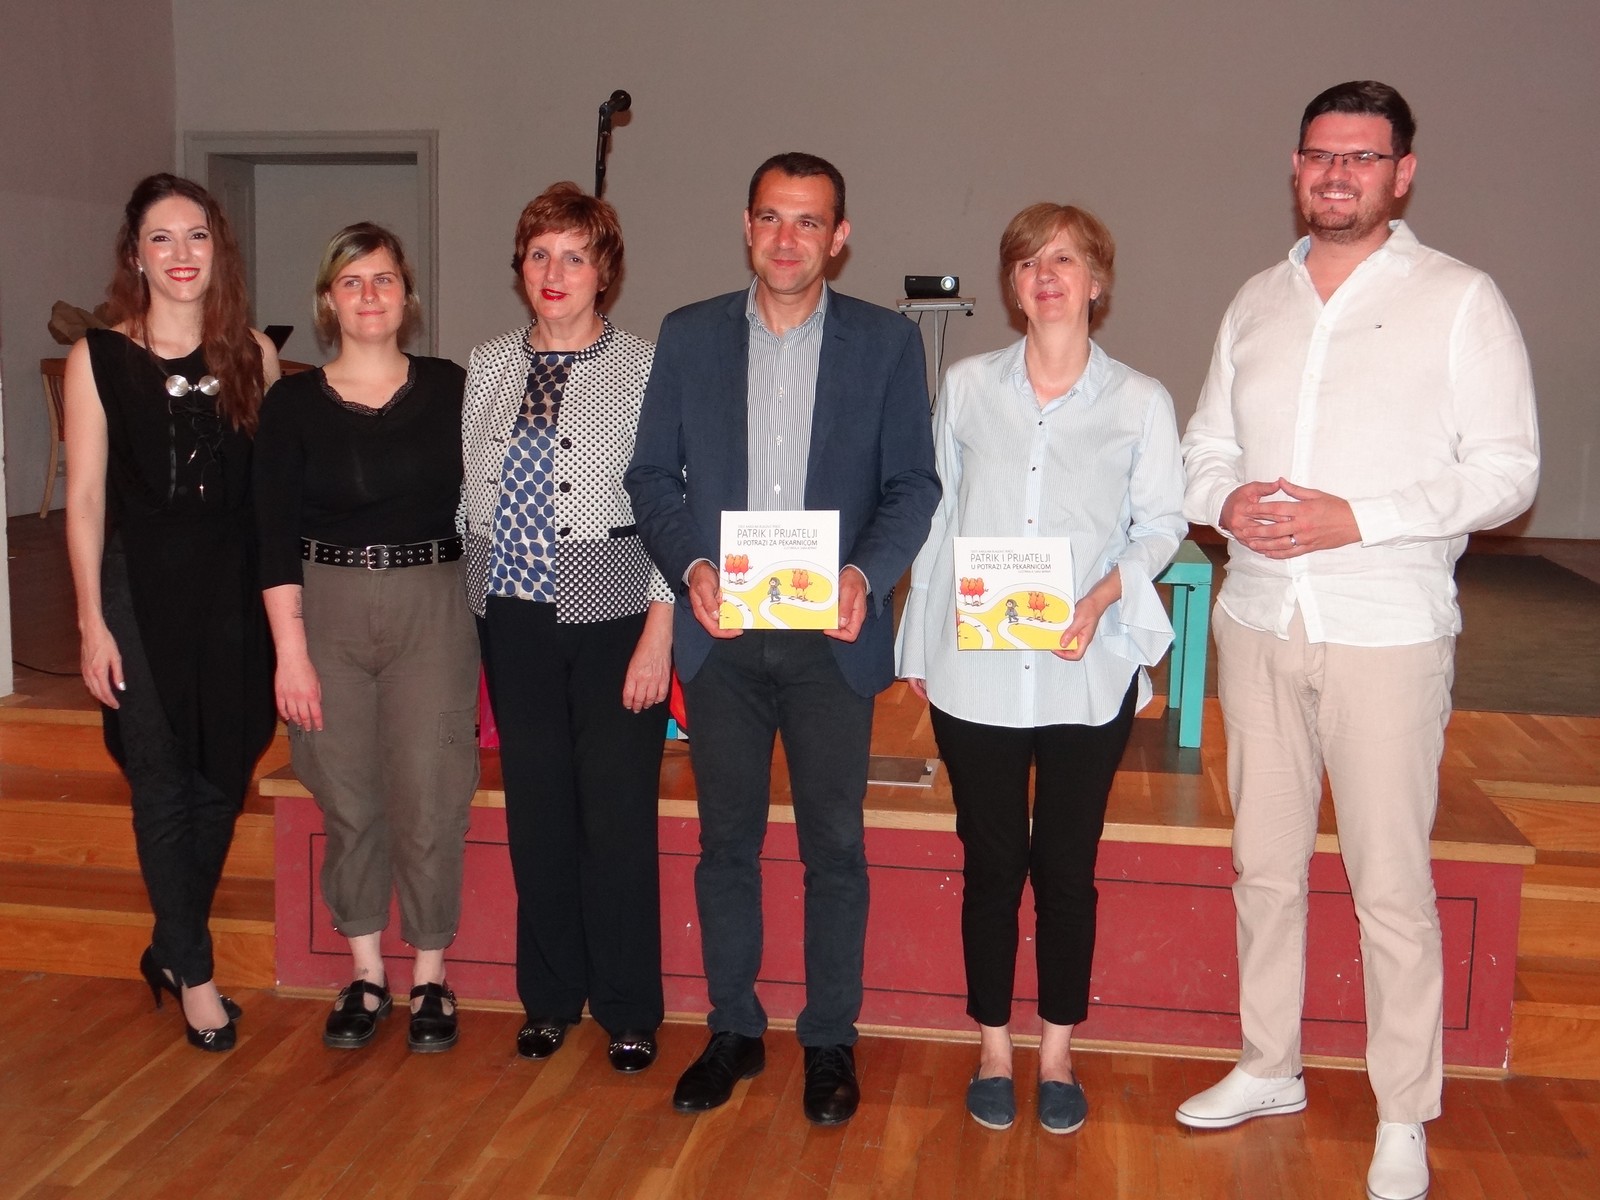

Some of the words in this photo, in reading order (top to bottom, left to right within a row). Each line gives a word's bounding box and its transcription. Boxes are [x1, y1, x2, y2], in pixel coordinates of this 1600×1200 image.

[737, 529, 766, 538] PATRIK
[774, 529, 818, 538] PRIJATELJI
[971, 554, 999, 562] PATRIK
[1008, 554, 1051, 562] PRIJATELJI
